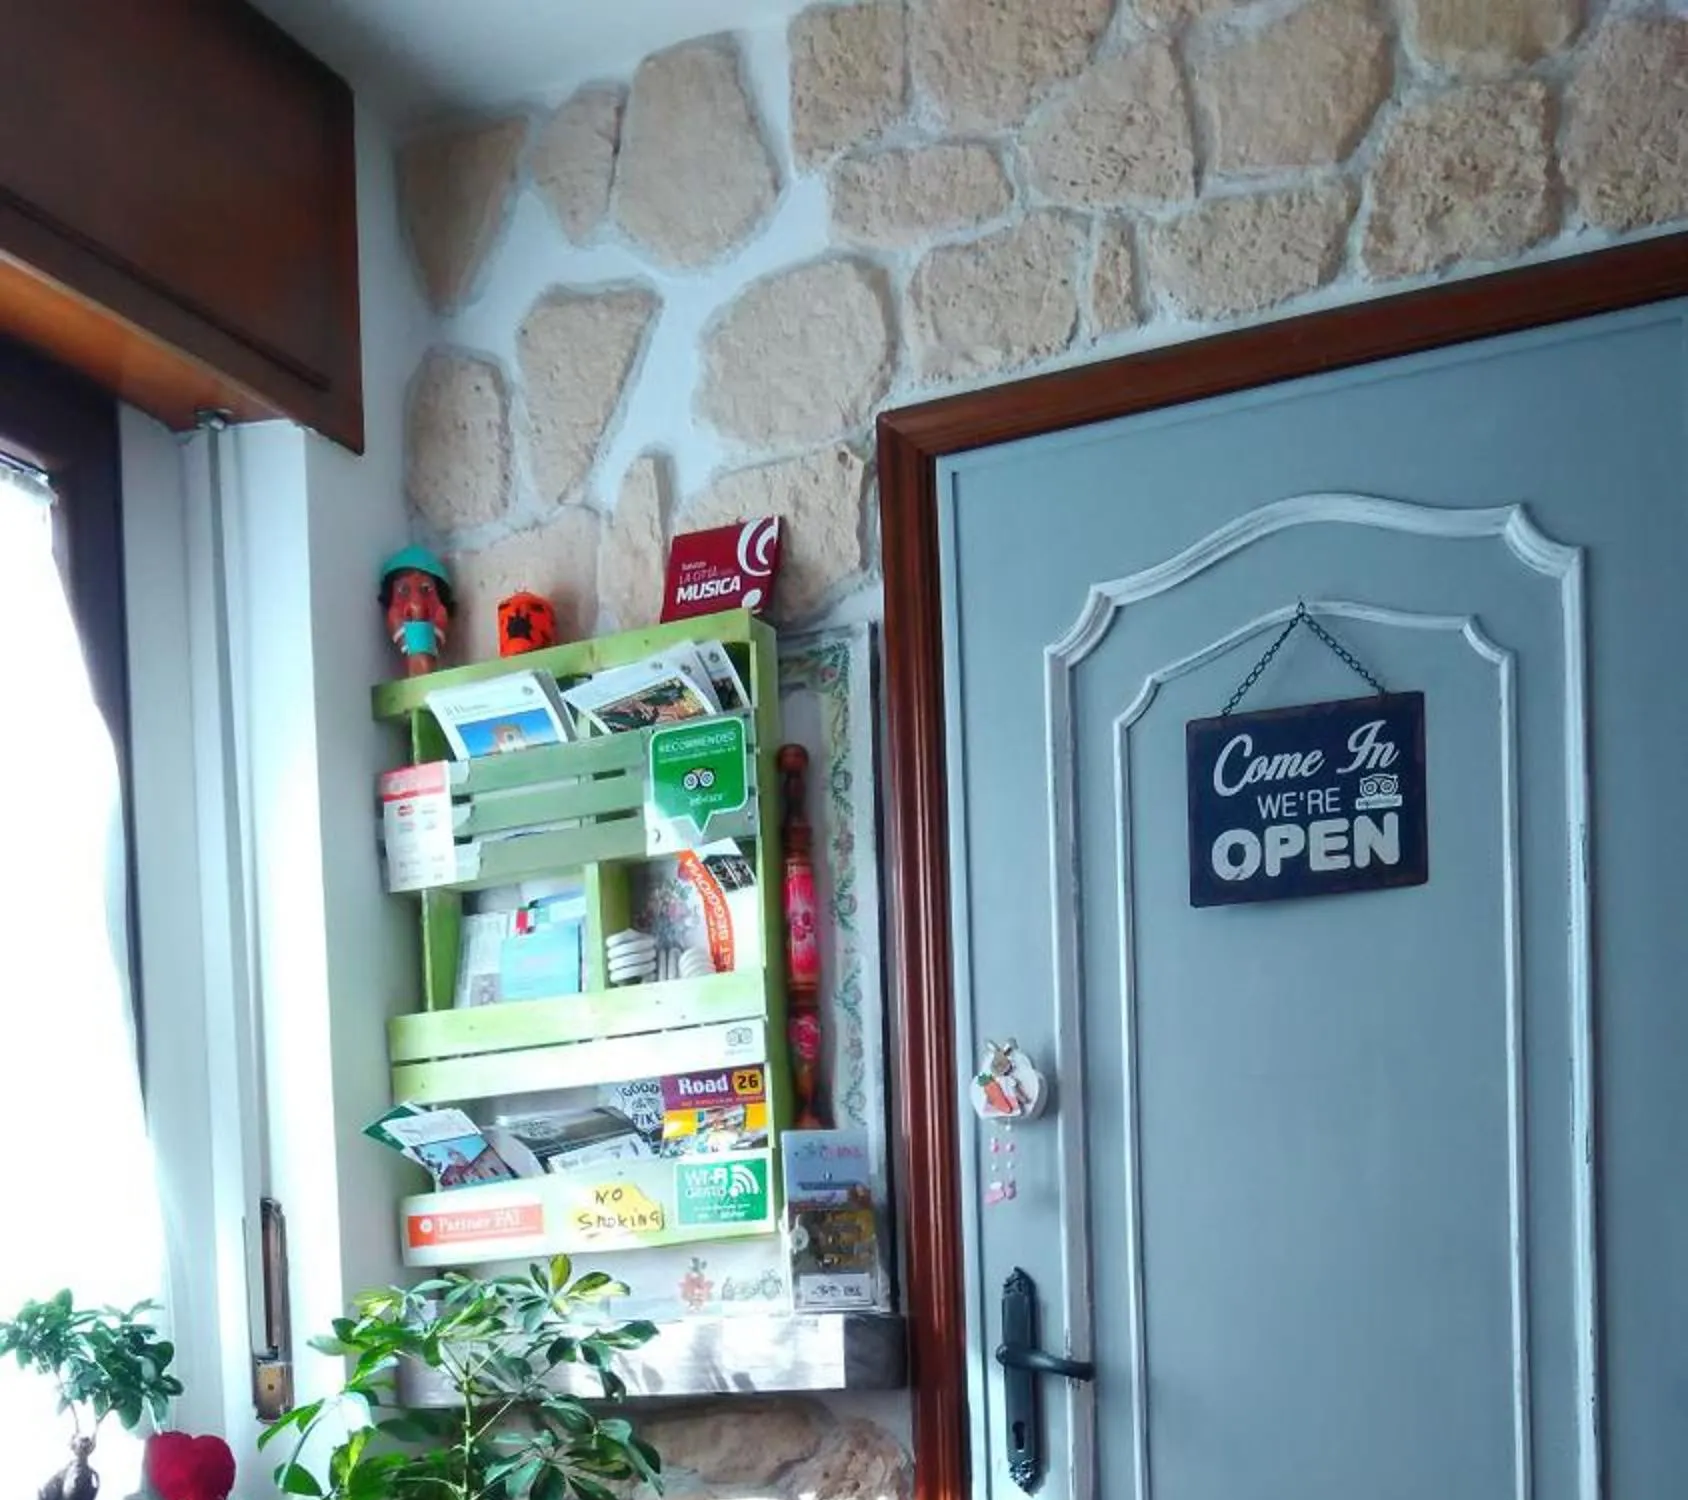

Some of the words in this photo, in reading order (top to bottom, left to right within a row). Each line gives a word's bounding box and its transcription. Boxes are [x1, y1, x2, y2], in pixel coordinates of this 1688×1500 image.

[675, 575, 741, 605] MUSICA
[657, 731, 737, 753] RECOMMENDED
[1213, 732, 1325, 797] Come
[1335, 719, 1400, 774] In
[1257, 787, 1342, 820] WE'RE
[1211, 811, 1402, 882] OPEN
[621, 1082, 660, 1097] GOOD
[677, 1073, 729, 1096] Road
[737, 1074, 760, 1090] 26
[594, 1187, 623, 1205] NO
